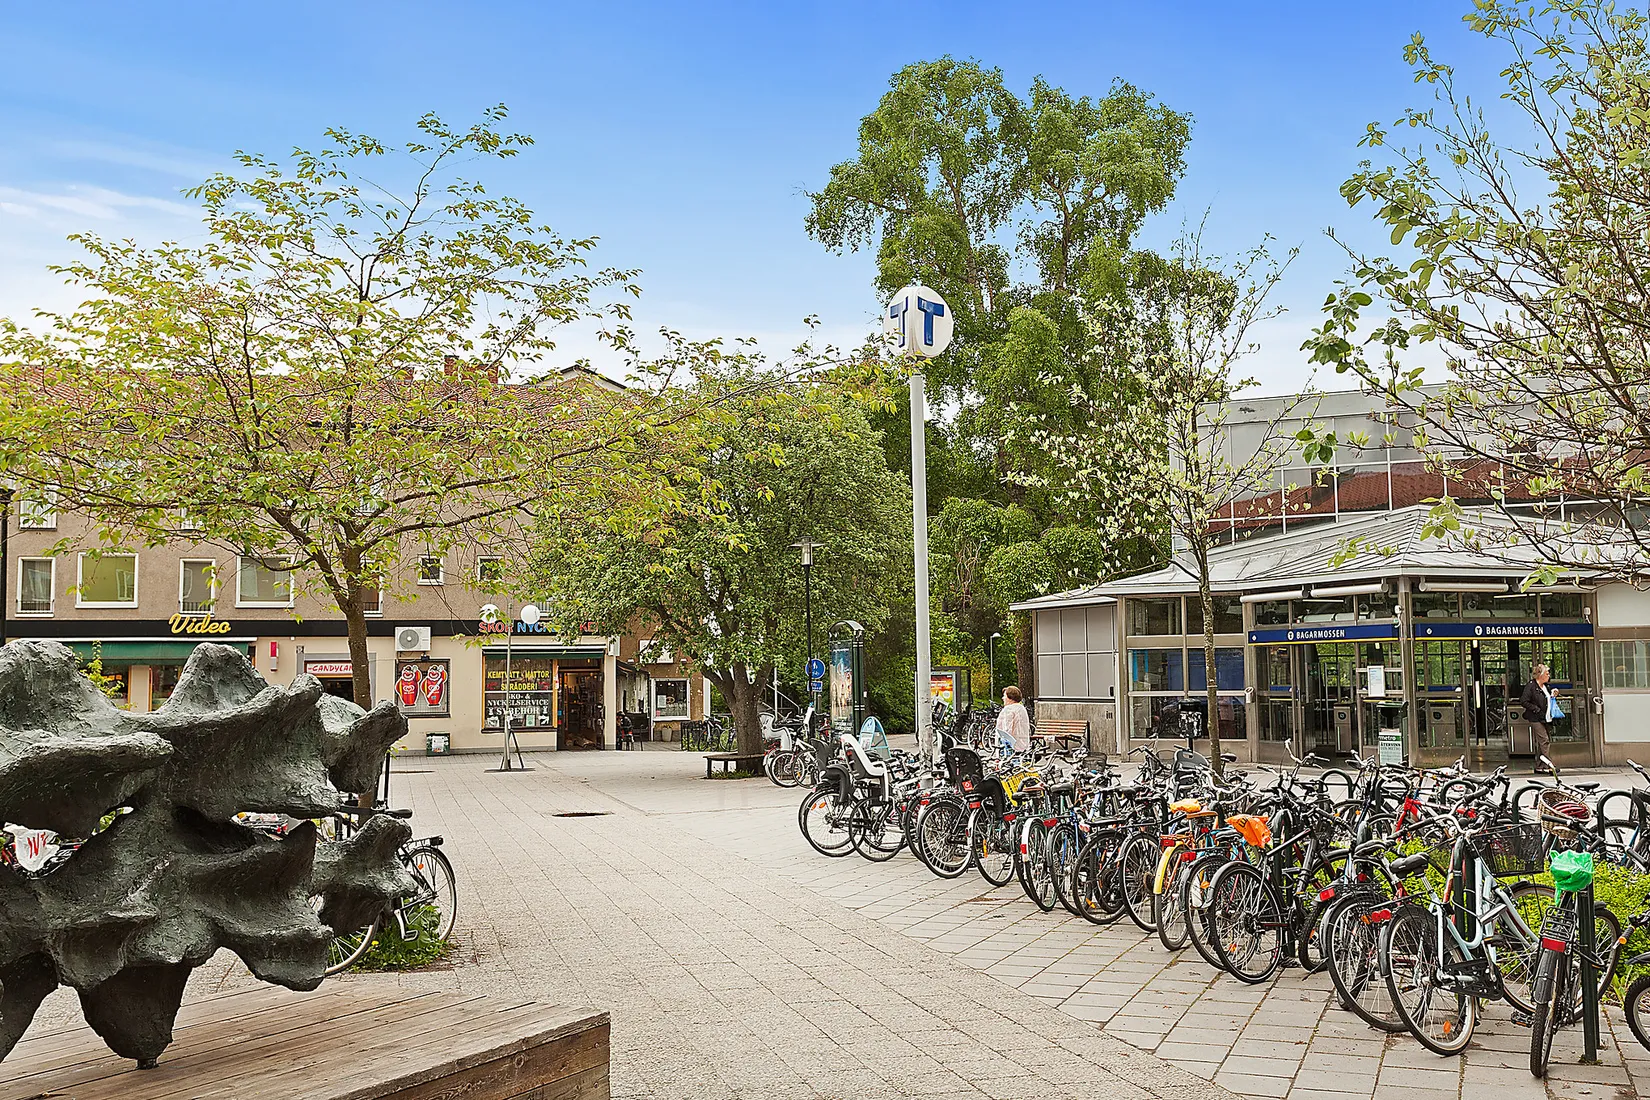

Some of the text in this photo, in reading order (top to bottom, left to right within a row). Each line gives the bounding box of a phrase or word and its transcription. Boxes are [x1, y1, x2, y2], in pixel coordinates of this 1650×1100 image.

[917, 295, 945, 347] T
[168, 613, 231, 634] Video
[1296, 629, 1345, 639] BAGARMOSSEN
[1486, 626, 1544, 635] BAGARMOSSEN
[500, 682, 538, 691] SRÄDDERI
